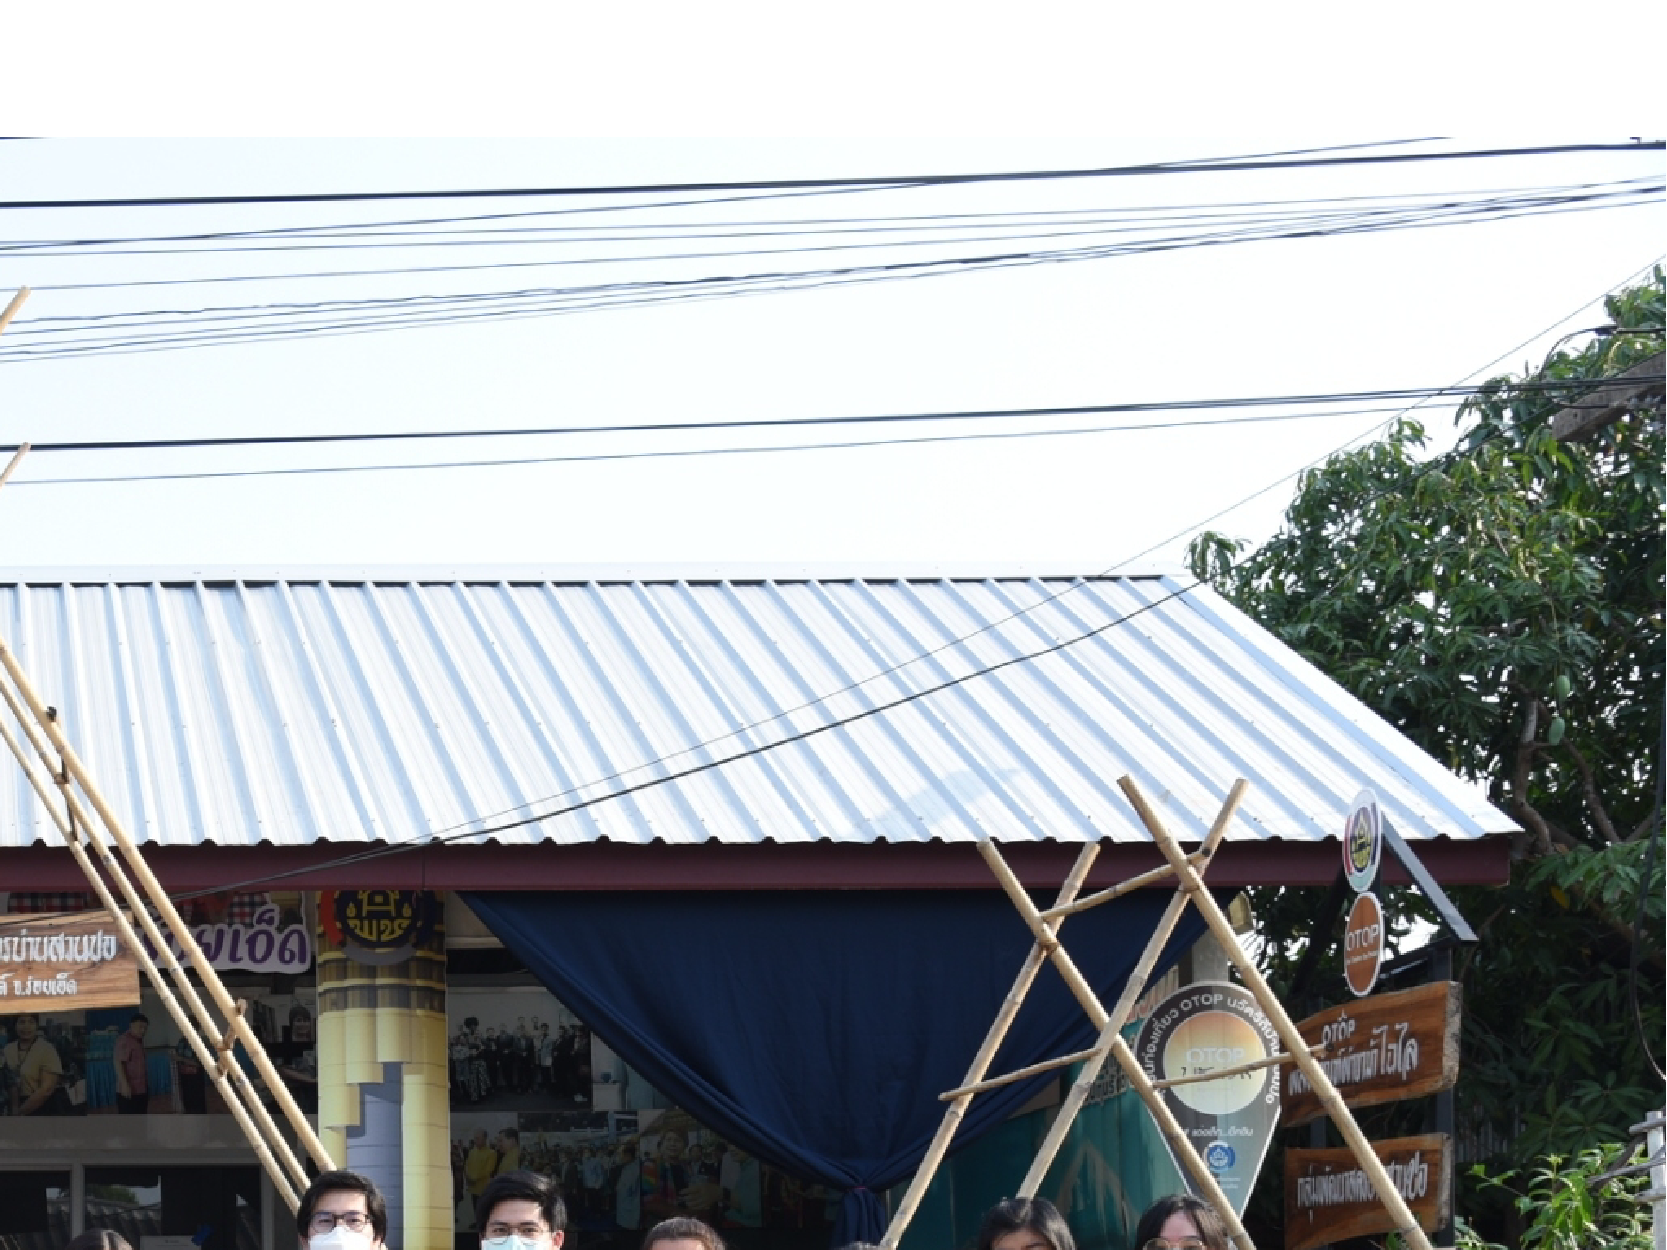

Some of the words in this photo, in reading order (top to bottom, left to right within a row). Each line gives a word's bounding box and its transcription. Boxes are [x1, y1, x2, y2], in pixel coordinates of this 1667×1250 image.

[1346, 924, 1379, 950] OTOP
[1180, 993, 1224, 1012] OTOP
[1323, 1018, 1356, 1046] OTOP
[1185, 1047, 1245, 1064] OTOP
